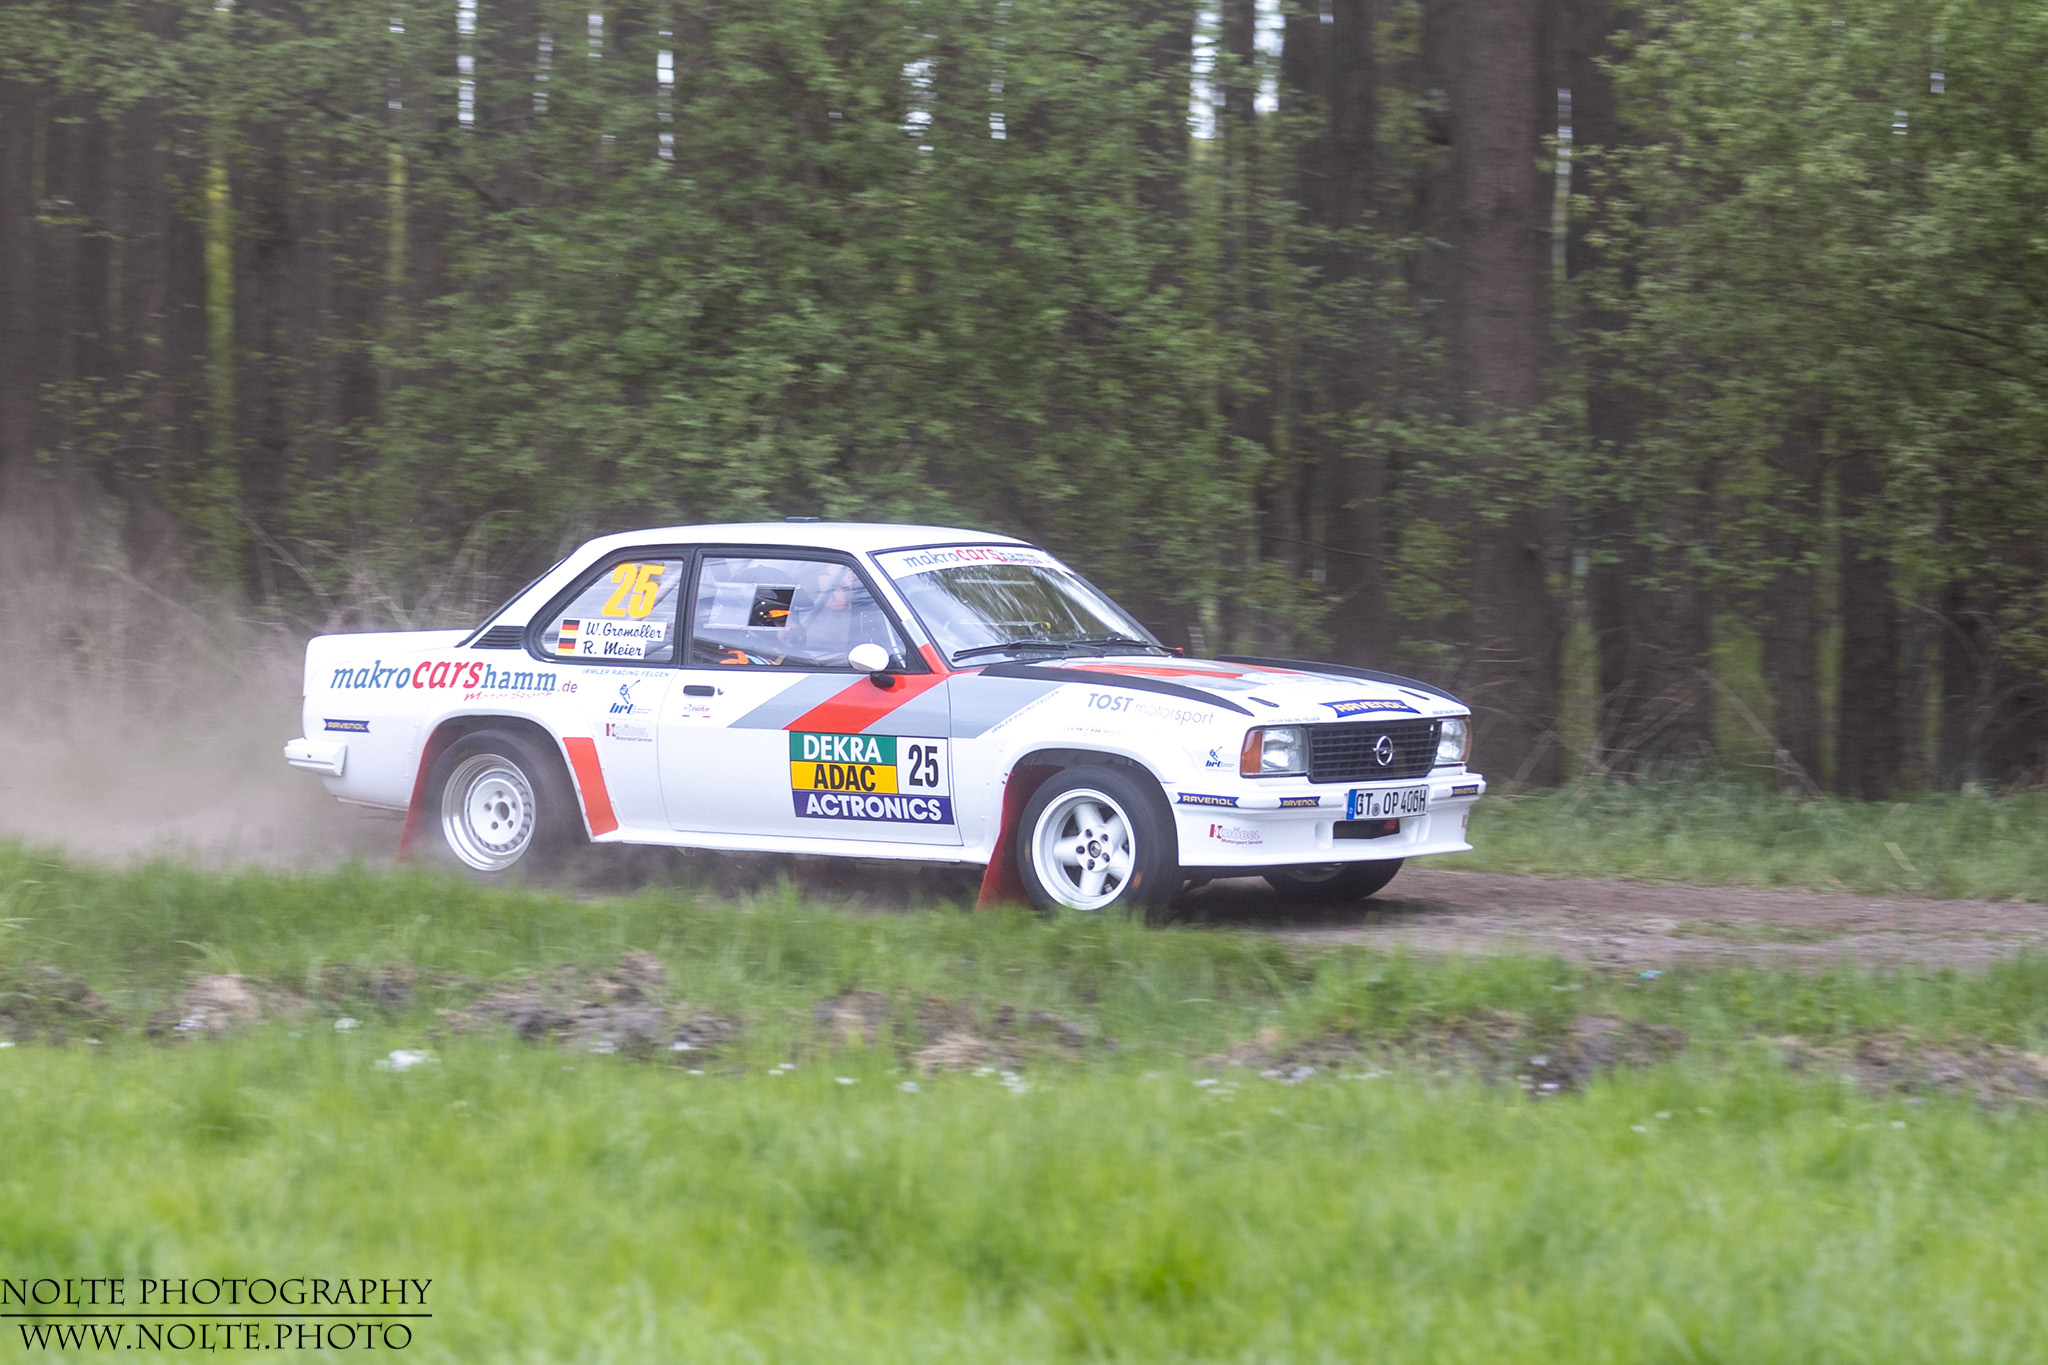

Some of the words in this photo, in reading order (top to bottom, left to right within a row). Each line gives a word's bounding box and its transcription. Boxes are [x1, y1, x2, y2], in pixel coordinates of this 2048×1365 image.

[601, 563, 666, 618] 25
[583, 640, 597, 655] R.
[604, 641, 642, 657] Meier
[612, 669, 639, 677] RACING
[641, 670, 670, 678] FELGEN
[1087, 693, 1134, 712] TOST
[1134, 702, 1215, 725] motorsport
[1335, 700, 1408, 713] RAVENOL
[327, 721, 366, 730] RAVENOL
[803, 734, 882, 763] DEKRA
[908, 744, 939, 788] 25
[813, 764, 876, 792] ADAC
[806, 794, 942, 821] ACTRONICS
[1183, 795, 1234, 806] RAVENOL
[1282, 799, 1317, 807] RAVENOL
[1355, 793, 1374, 815] GT
[1383, 792, 1399, 815] OP
